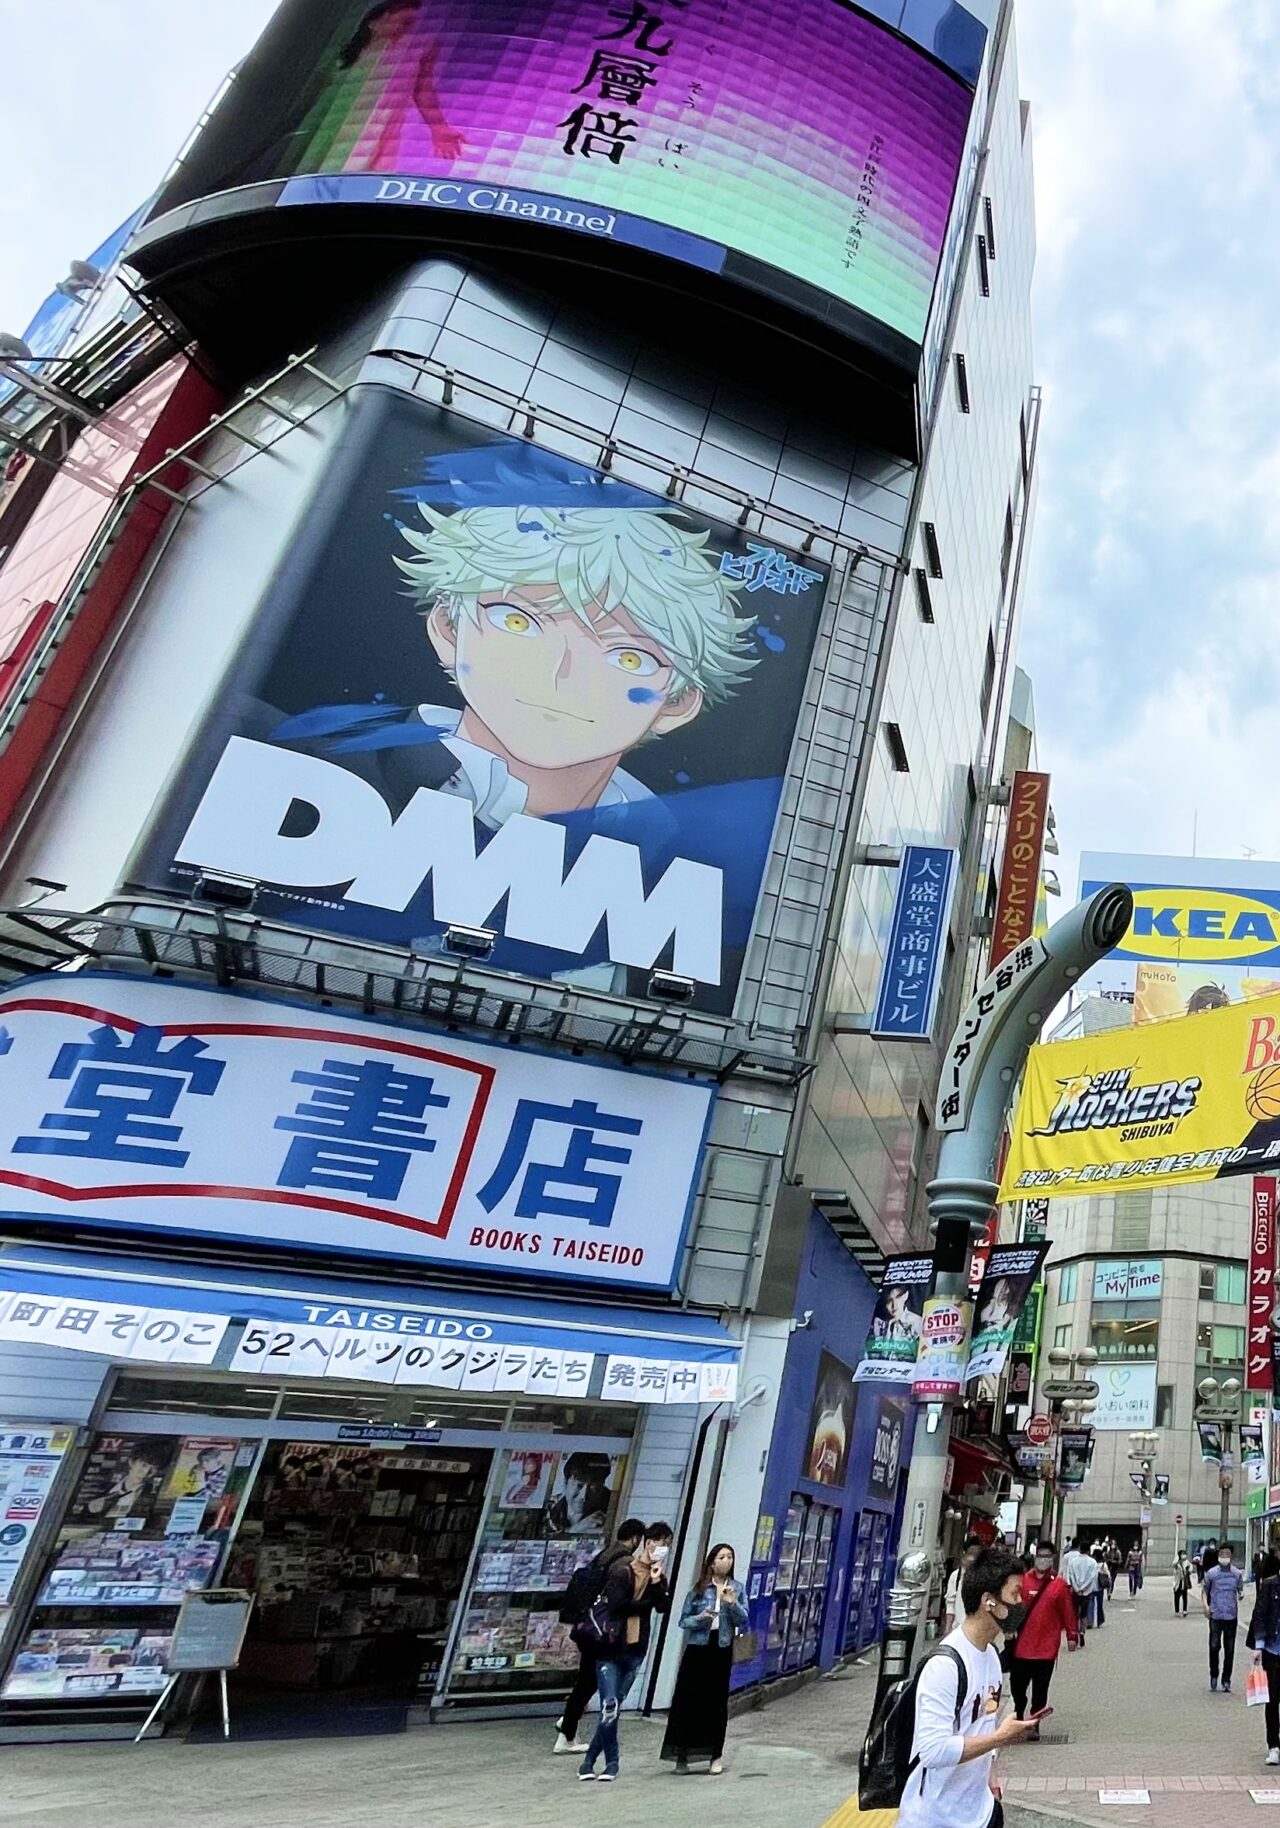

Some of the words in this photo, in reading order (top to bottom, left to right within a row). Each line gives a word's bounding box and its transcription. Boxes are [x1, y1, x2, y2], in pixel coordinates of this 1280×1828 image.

[555, 0, 676, 165] 九層倍
[374, 180, 462, 205] DHC
[466, 189, 618, 235] Channel
[174, 735, 724, 986] DMM
[1002, 780, 1042, 949] クスリのことなら
[888, 857, 942, 1025] 大盛堂商事ビル
[1133, 907, 1278, 942] KEA
[941, 945, 1033, 1124] 渋谷センター街
[1089, 1068, 1131, 1094] SUN
[0, 1022, 643, 1229] 堂書店
[1119, 1121, 1175, 1143] SHIBUYA
[469, 1227, 542, 1254] BOOKS
[552, 1237, 645, 1267] TAISEIDO
[9, 1301, 216, 1345] 町田そのこ
[302, 1305, 494, 1340] TAISEIDO
[927, 1313, 959, 1329] STOP
[1249, 1267, 1272, 1374] カラオケ
[242, 1328, 588, 1383] 52ヘルツのクジラたち
[608, 1362, 697, 1392] 発売中
